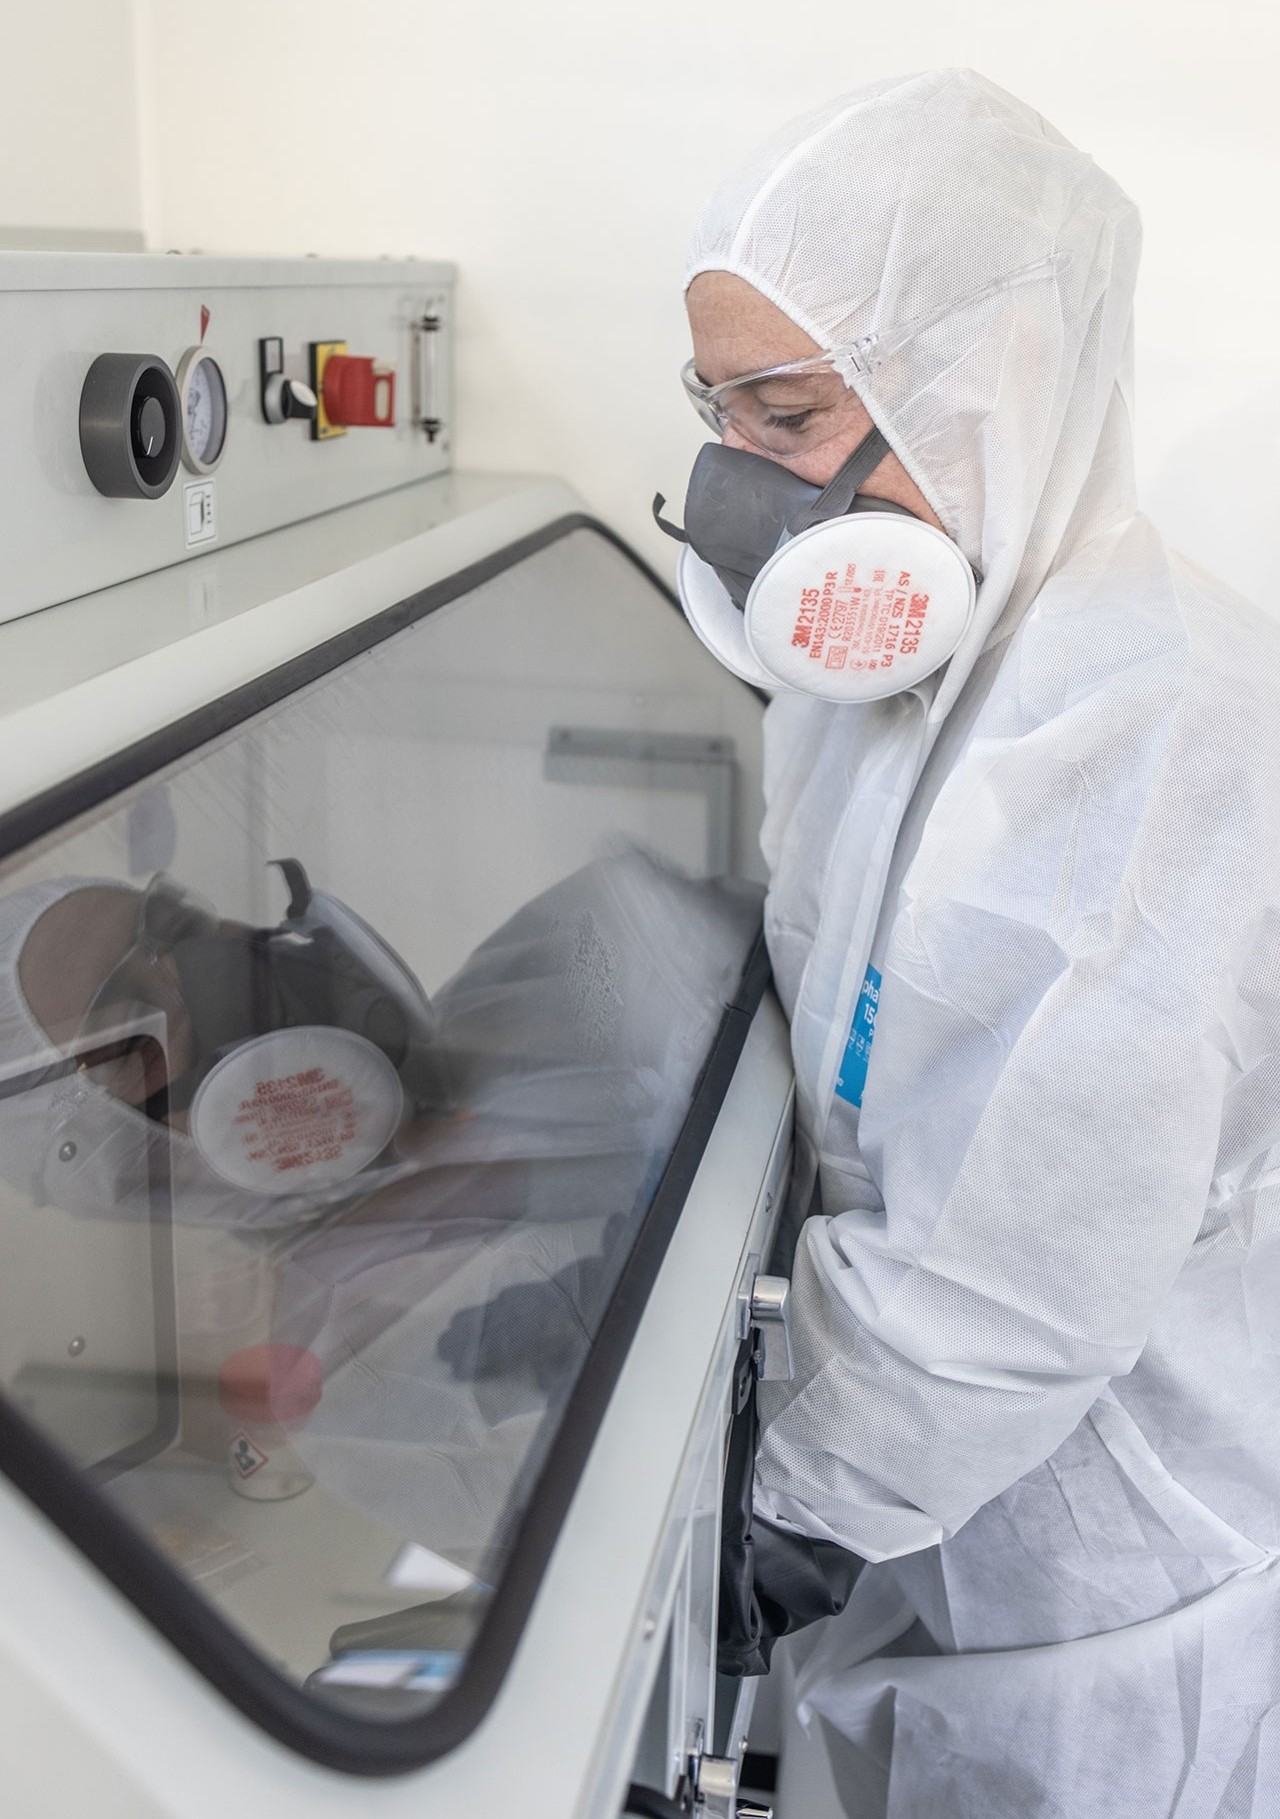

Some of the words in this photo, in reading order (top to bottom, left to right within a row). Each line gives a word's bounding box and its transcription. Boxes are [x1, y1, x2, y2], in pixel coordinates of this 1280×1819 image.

[826, 571, 838, 580] R
[898, 571, 911, 586] AS
[823, 581, 835, 596] P3
[797, 588, 820, 624] 2135
[892, 598, 906, 619] NZS
[908, 593, 930, 619] 3M
[791, 625, 811, 648] 3M
[809, 597, 832, 659] EN143:2000
[885, 624, 900, 650] 1716
[899, 620, 923, 654] 2135
[881, 654, 893, 668] P3
[862, 981, 880, 1003] pha
[864, 1003, 877, 1026] 15
